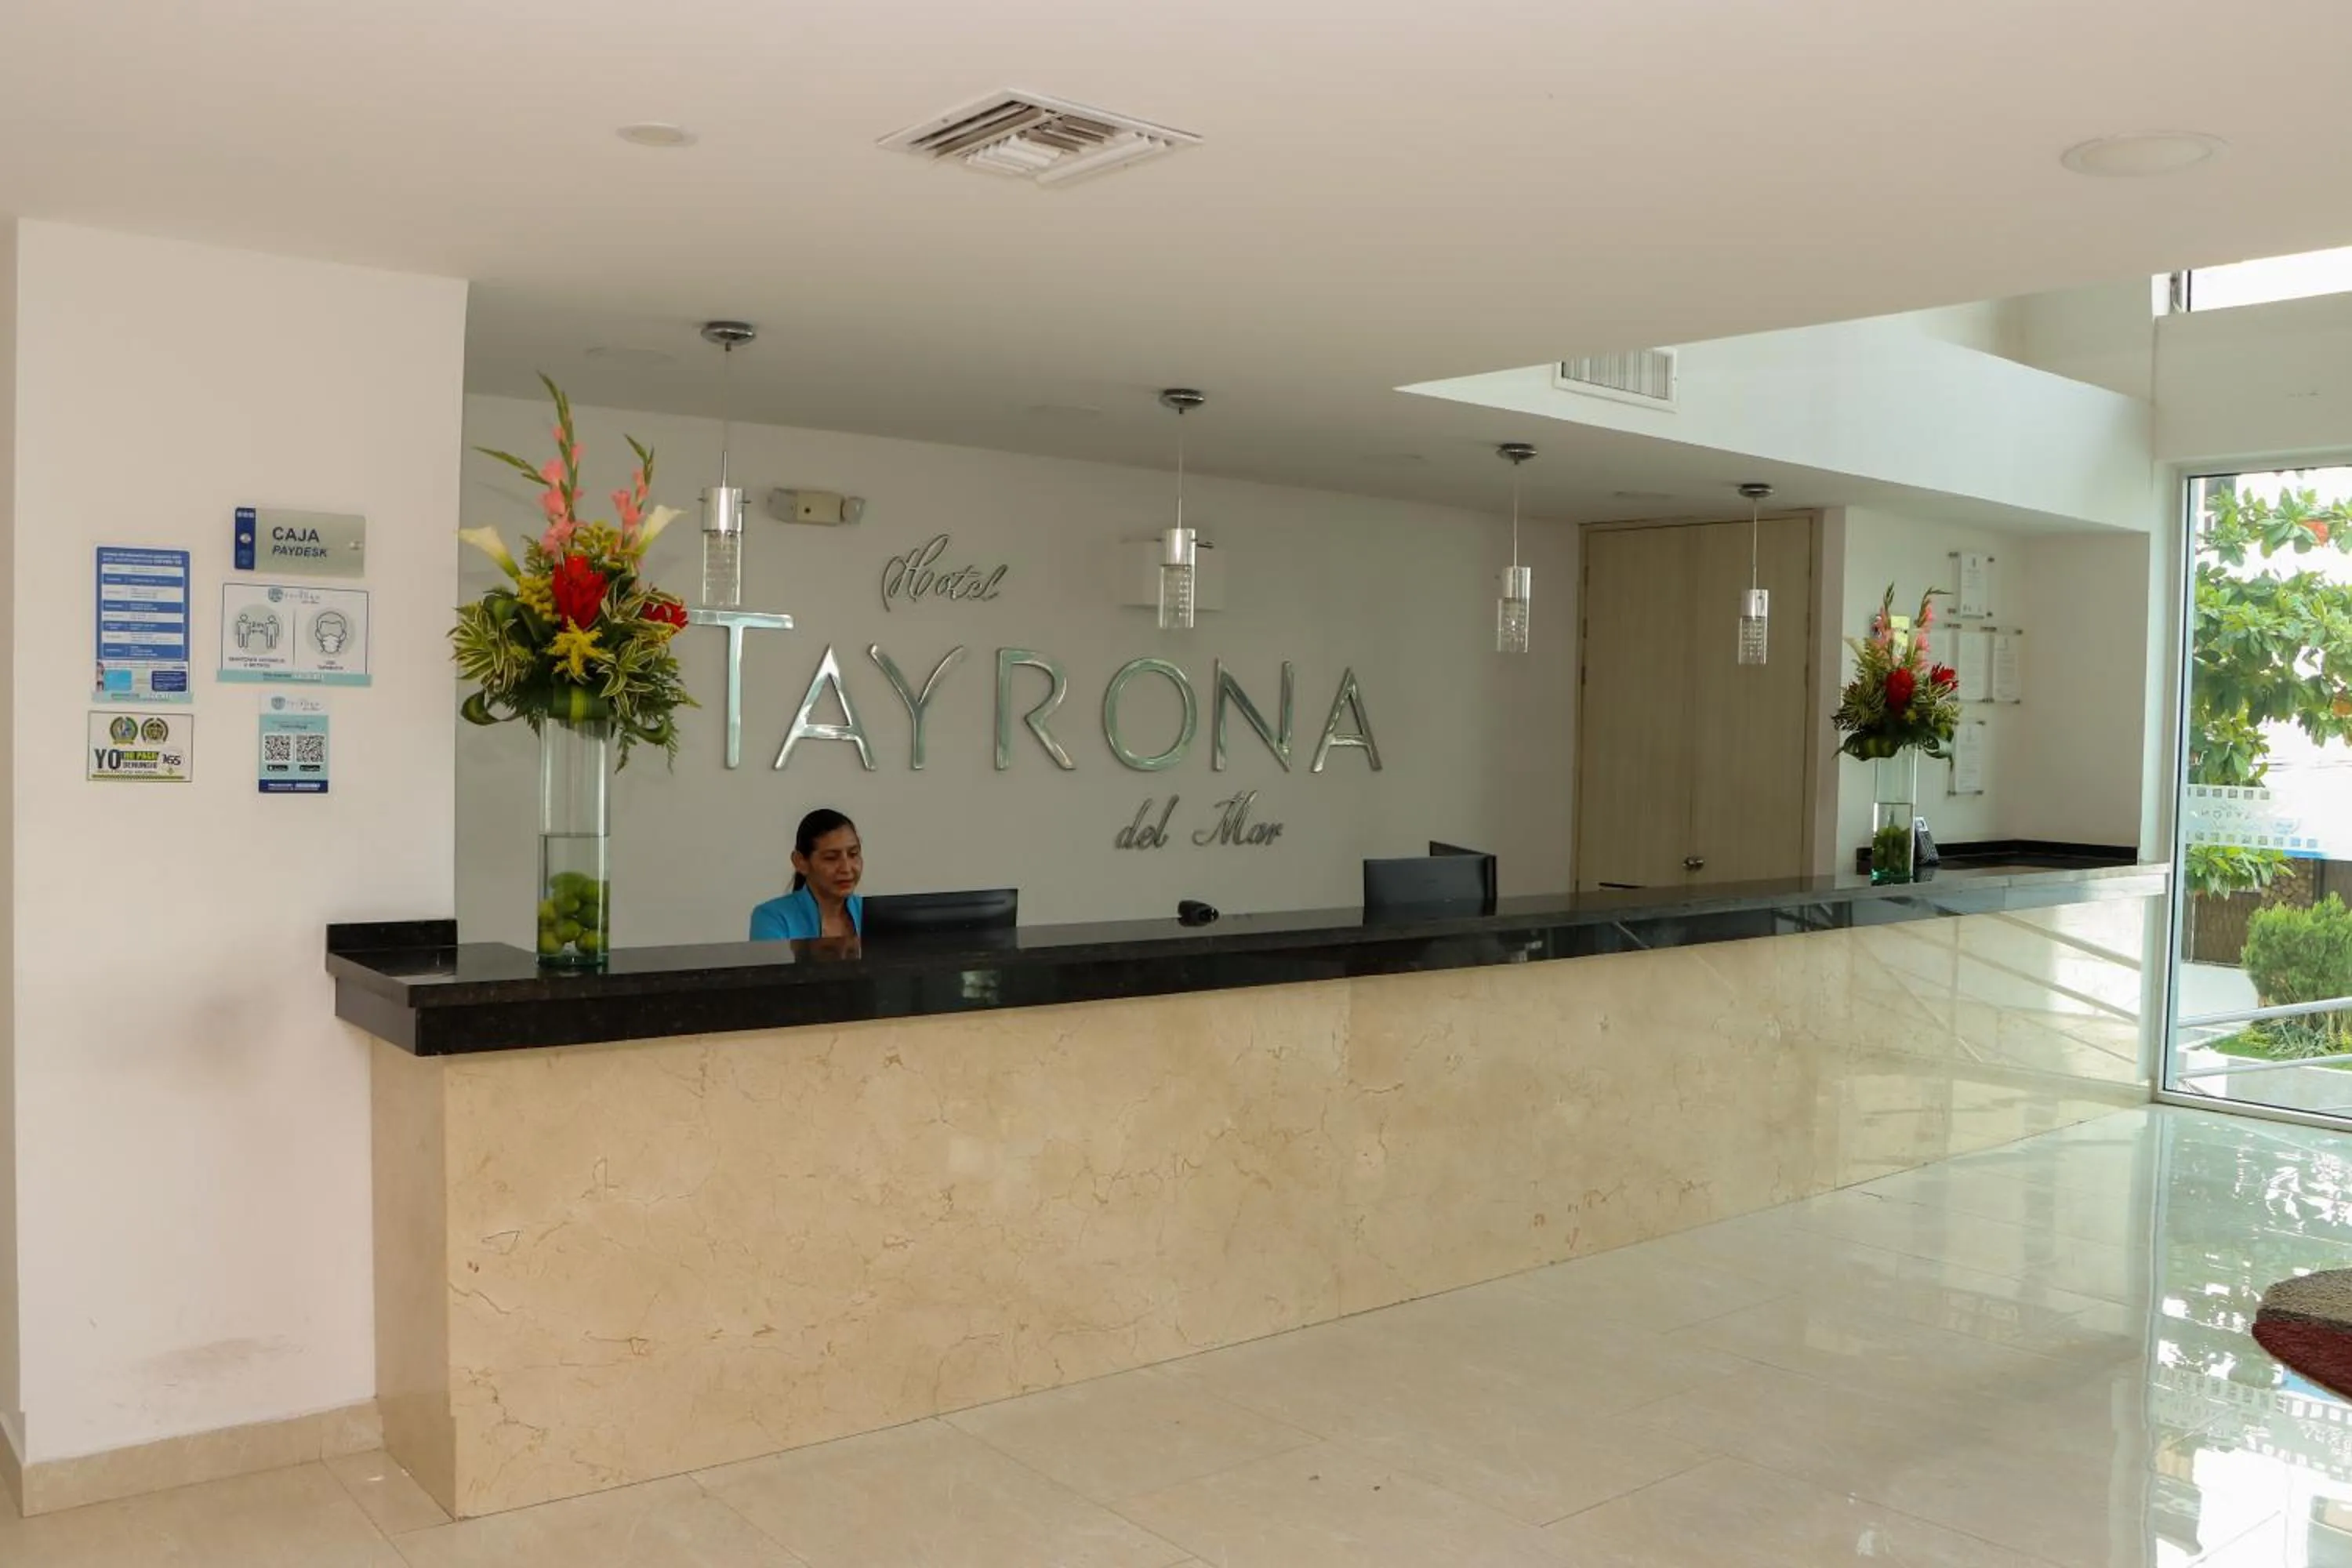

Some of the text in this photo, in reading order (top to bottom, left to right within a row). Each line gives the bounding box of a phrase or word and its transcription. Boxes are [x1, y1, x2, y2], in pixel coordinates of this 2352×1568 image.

[271, 526, 320, 543] CAJA
[271, 545, 327, 557] PAYDESK
[881, 534, 1009, 612] Hotel
[688, 608, 1383, 773] TAYRONA
[94, 748, 122, 769] YO
[1114, 789, 1283, 851] del Mar
